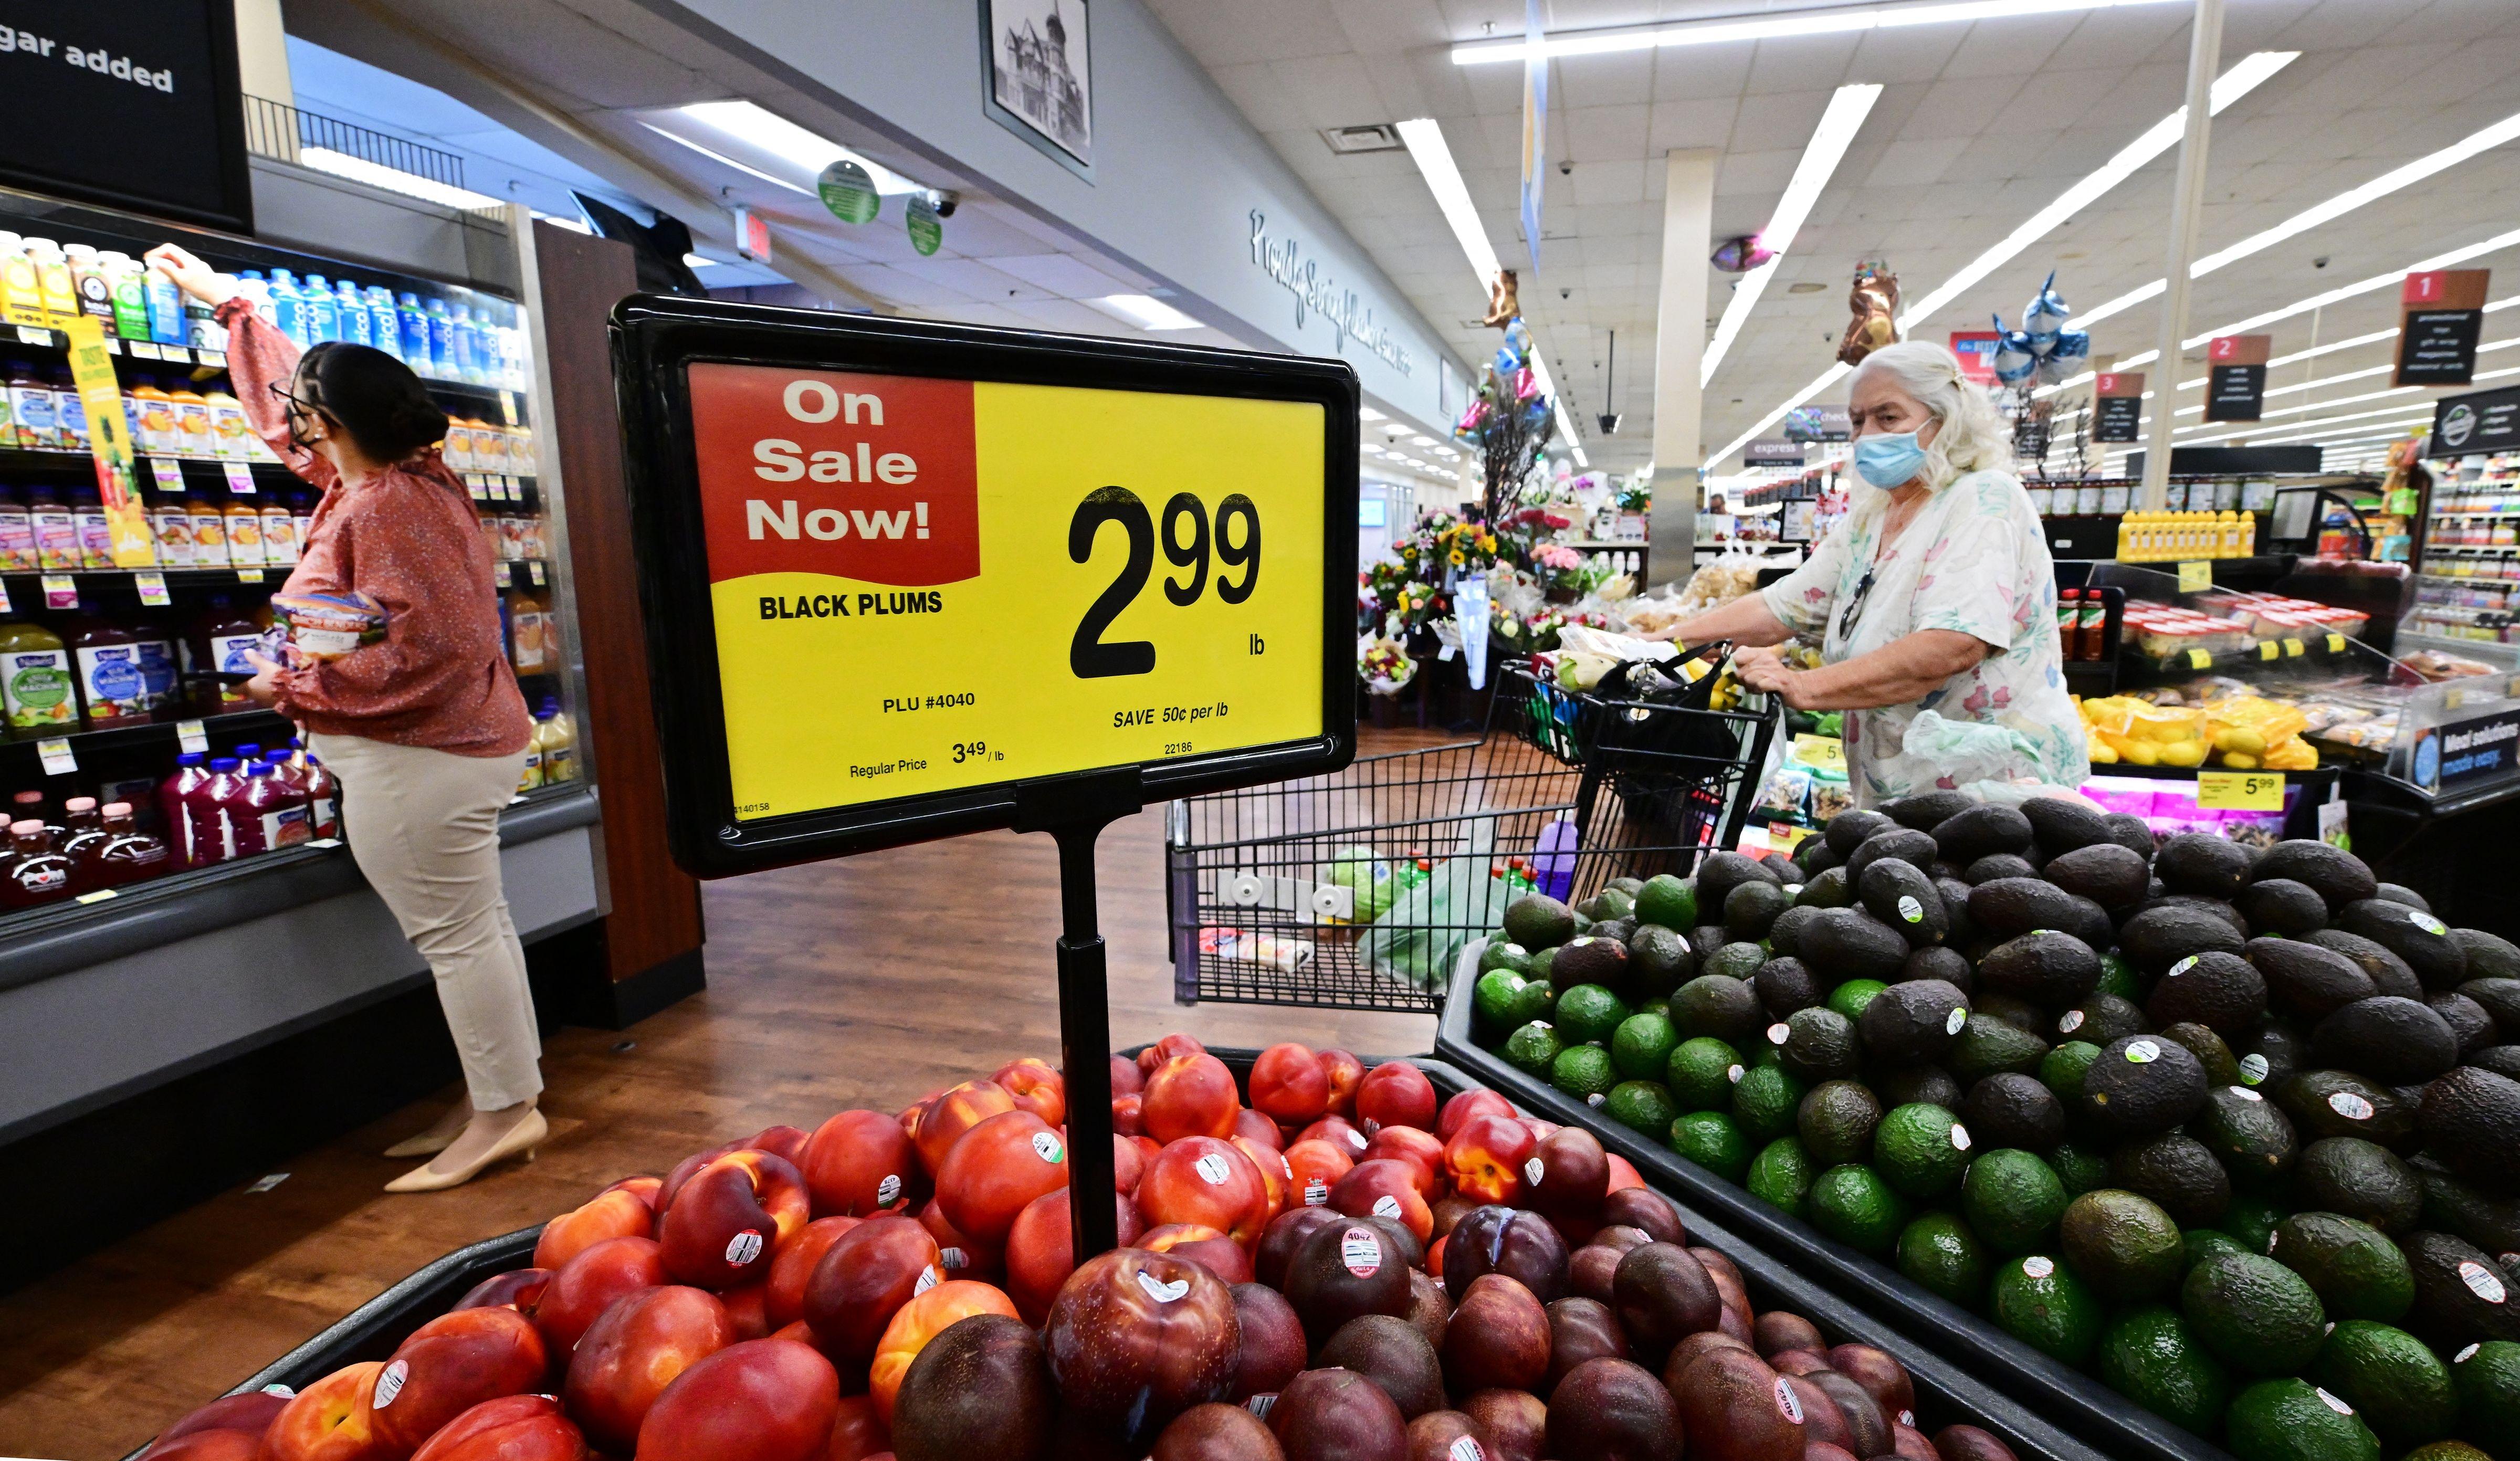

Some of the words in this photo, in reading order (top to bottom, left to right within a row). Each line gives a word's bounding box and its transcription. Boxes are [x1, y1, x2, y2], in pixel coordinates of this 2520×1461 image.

[65, 45, 174, 93] added
[1250, 209, 1305, 330] Proudly
[2420, 277, 2431, 297] 1
[2218, 340, 2231, 356] 2
[2102, 376, 2113, 390] 3
[784, 380, 884, 426] On
[1754, 443, 1797, 455] express
[753, 438, 918, 485] Sale
[746, 499, 929, 541] Now!
[760, 594, 850, 619] BLACK
[858, 591, 942, 616] PLUMS
[1250, 633, 1265, 656] lb
[883, 697, 919, 713] PLU
[925, 692, 975, 710] #4040
[1114, 709, 1156, 729] SAVE
[1190, 706, 1213, 724] per
[1216, 702, 1228, 717] lb
[1164, 741, 1192, 754] 22186
[850, 762, 895, 779] Regular
[898, 760, 927, 772] Price
[1348, 1232, 1371, 1241] 4042
[1777, 1387, 1793, 1416] 4042
